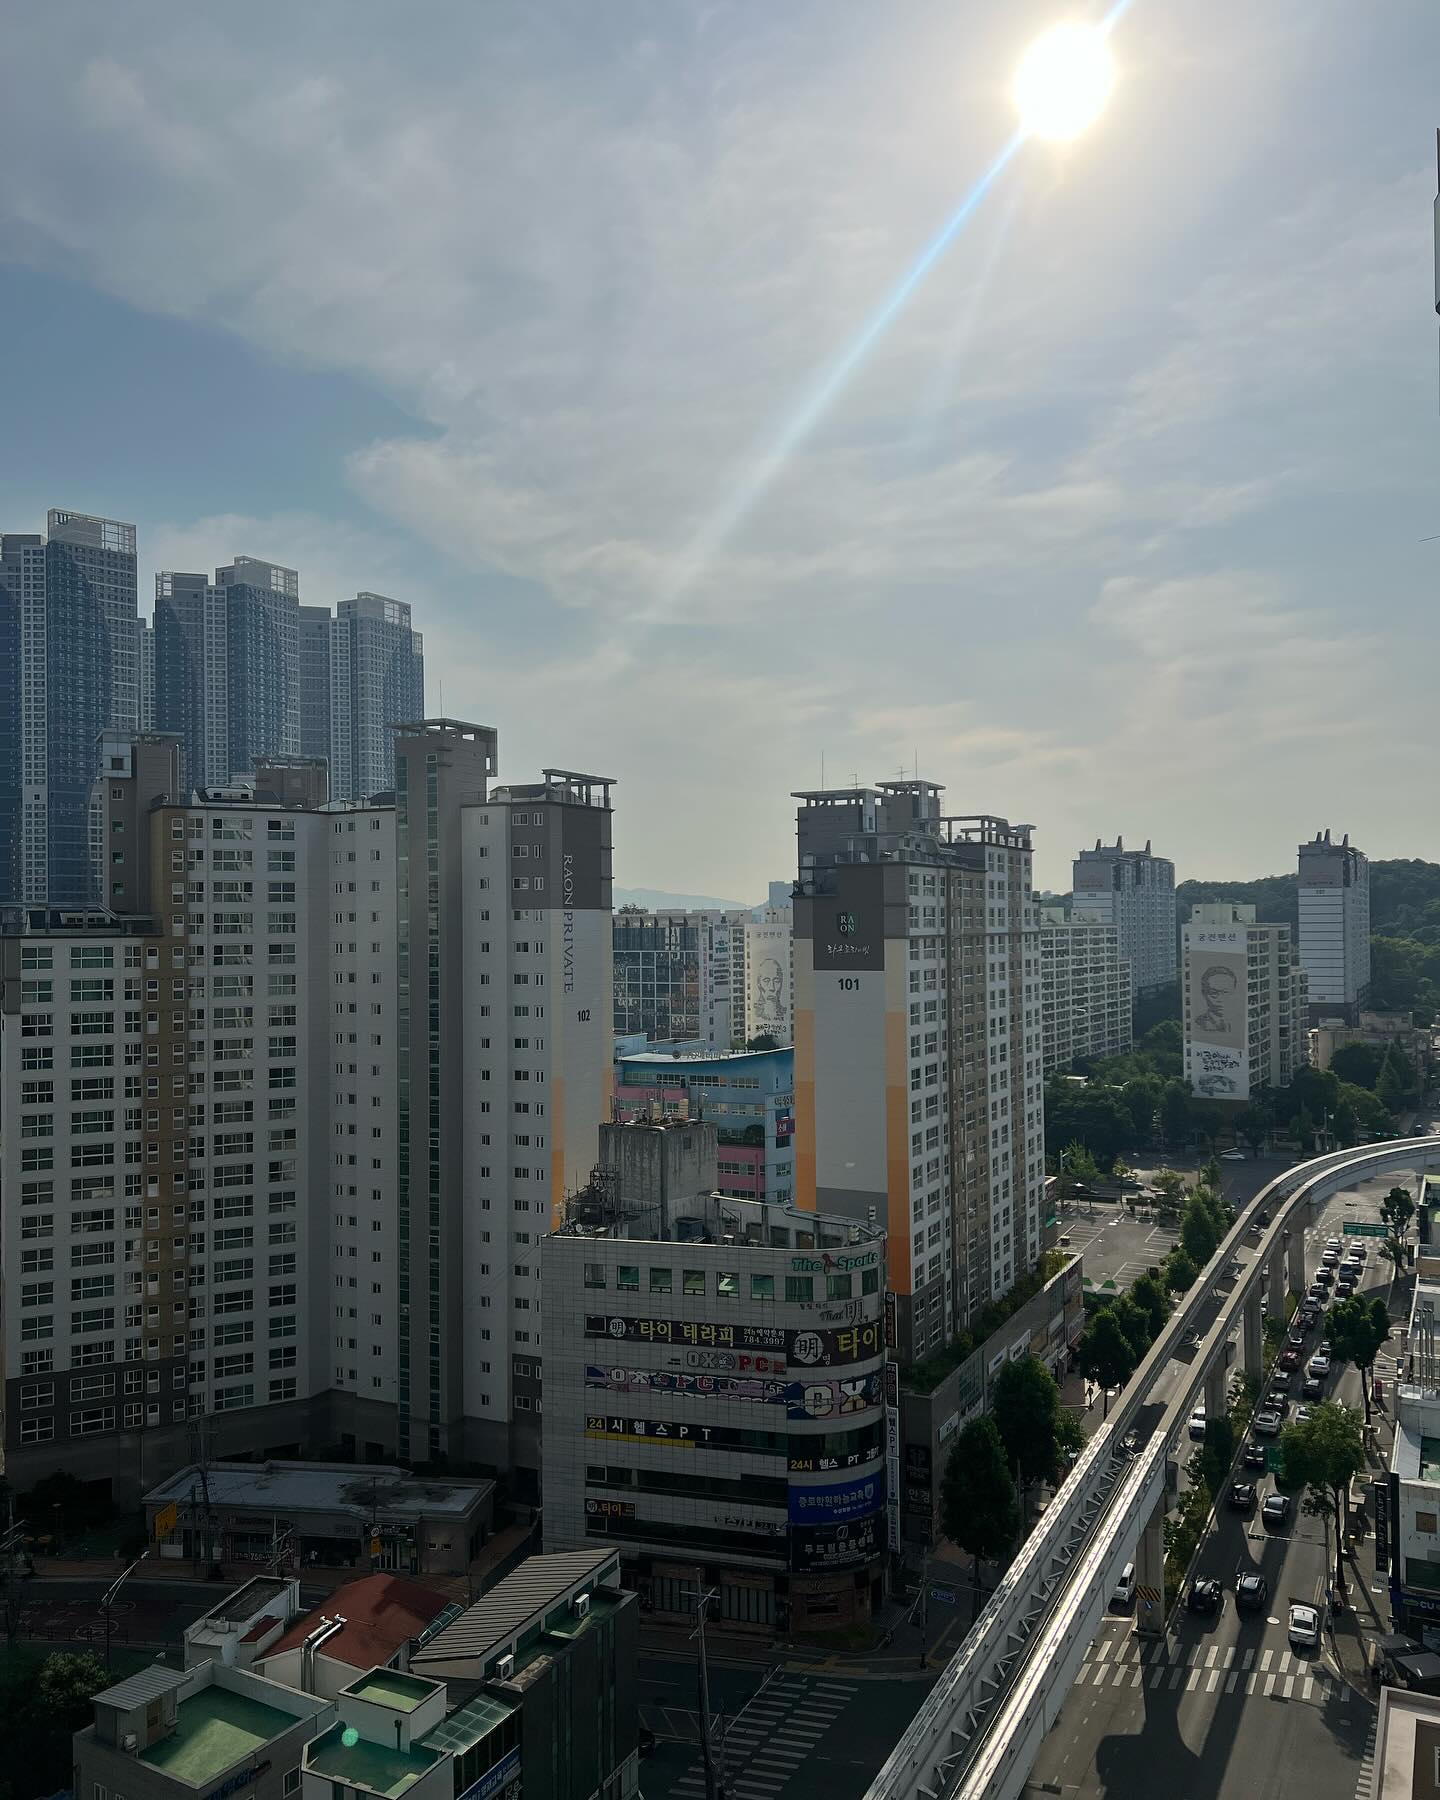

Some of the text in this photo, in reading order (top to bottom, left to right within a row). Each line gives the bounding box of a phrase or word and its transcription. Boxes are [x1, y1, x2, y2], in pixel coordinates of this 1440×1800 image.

[564, 855, 574, 993] RAON PRIVATE
[838, 978, 860, 991] 101
[577, 1009, 591, 1022] 102
[792, 1251, 879, 1271] The Sports
[640, 1320, 672, 1342] 타이
[682, 1323, 734, 1347] 테라피
[837, 1322, 878, 1360] 타이
[738, 1355, 769, 1372] PC
[790, 1459, 813, 1470] 24시
[819, 1458, 838, 1470] 헬스
[848, 1455, 860, 1466] PT
[1420, 1601, 1435, 1610] CU
